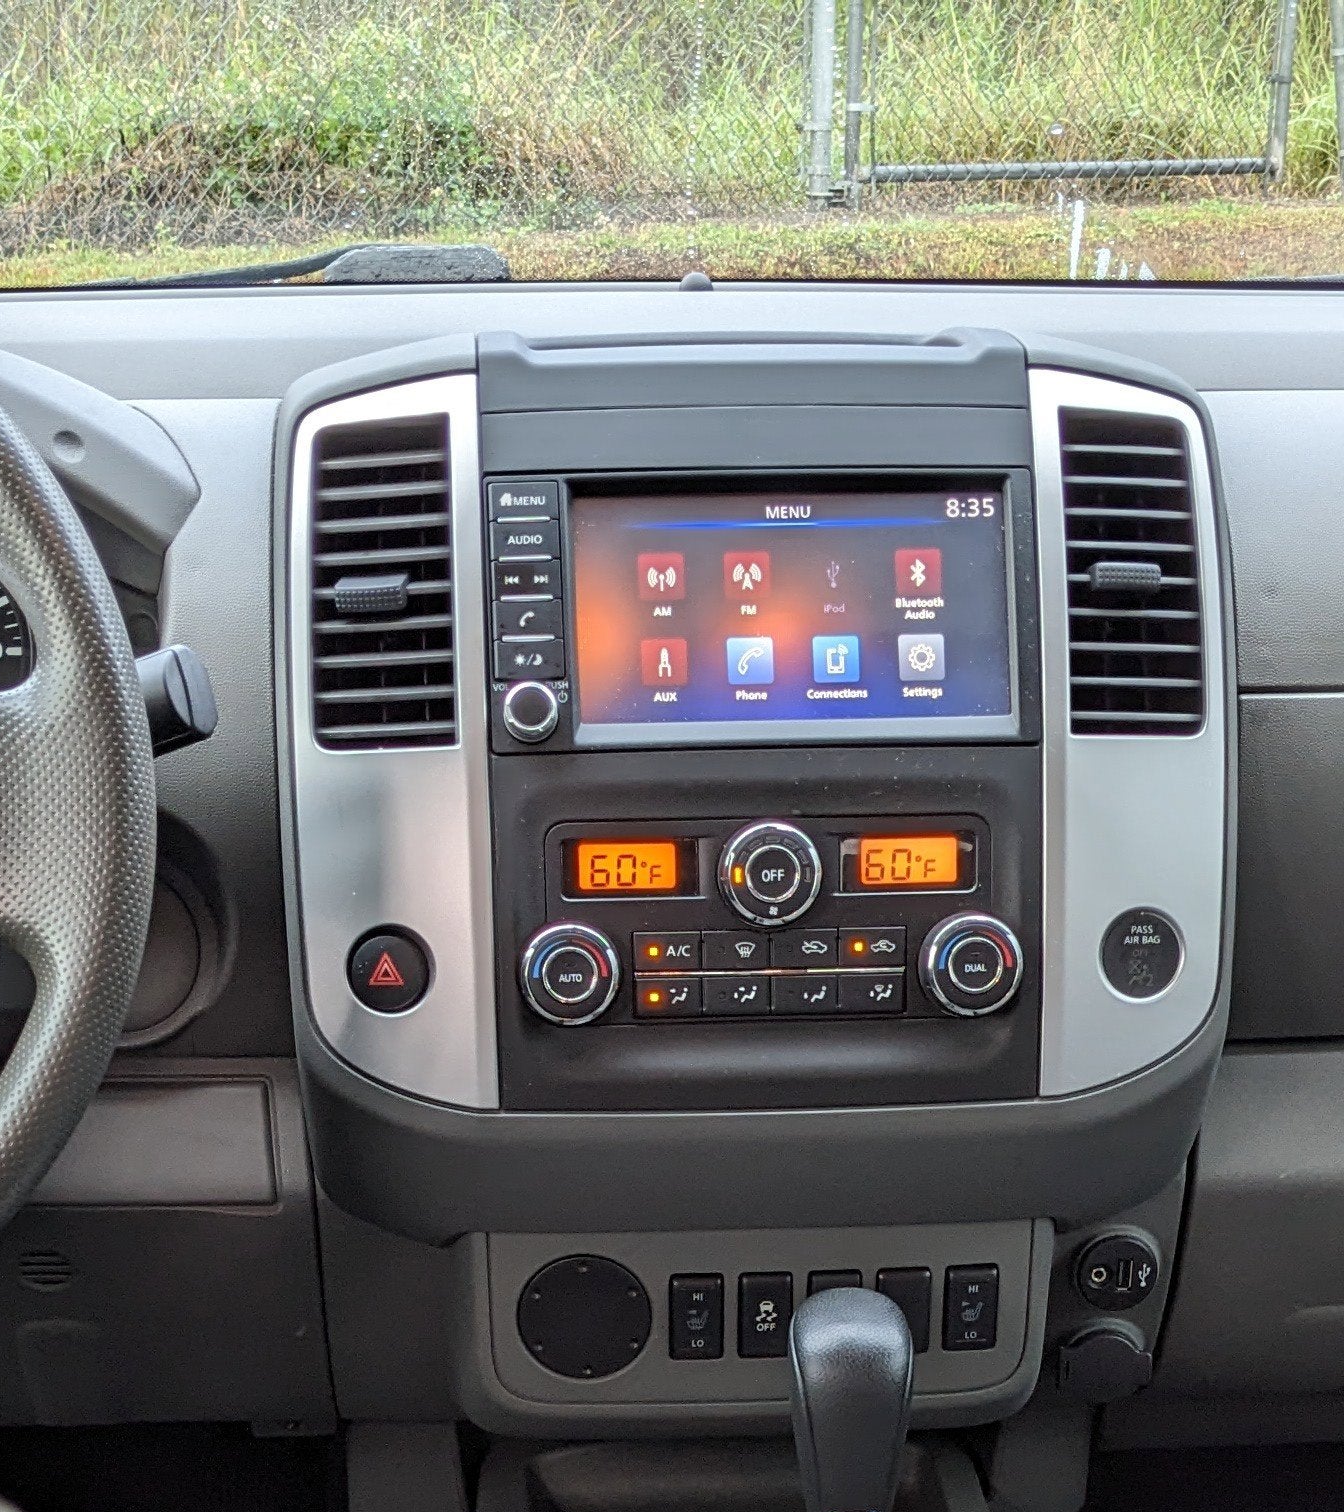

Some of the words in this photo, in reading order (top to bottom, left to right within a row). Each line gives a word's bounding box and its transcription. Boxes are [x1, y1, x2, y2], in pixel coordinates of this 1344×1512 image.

[513, 496, 546, 506] MENU
[766, 505, 811, 519] MENU
[946, 498, 995, 518] 8:35
[507, 535, 543, 544] AUDIO
[895, 597, 944, 608] Bluetooth
[653, 606, 672, 617] AM
[741, 605, 757, 615] FM
[823, 603, 846, 614] iPod
[905, 609, 935, 620] Audio
[653, 691, 677, 702] AUX
[736, 690, 768, 701] Phone
[806, 689, 868, 700] Connections
[902, 687, 943, 699] Settings
[761, 869, 785, 882] OFF
[1131, 925, 1154, 934] PASS
[1124, 936, 1140, 944] AIR
[1142, 935, 1161, 944] BAG
[666, 945, 691, 958] A/C
[964, 964, 987, 972] DUAL
[559, 973, 582, 983] AUTO
[968, 1285, 979, 1293] HI
[692, 1293, 704, 1301] HI
[756, 1323, 776, 1332] OFF
[964, 1331, 977, 1339] LO
